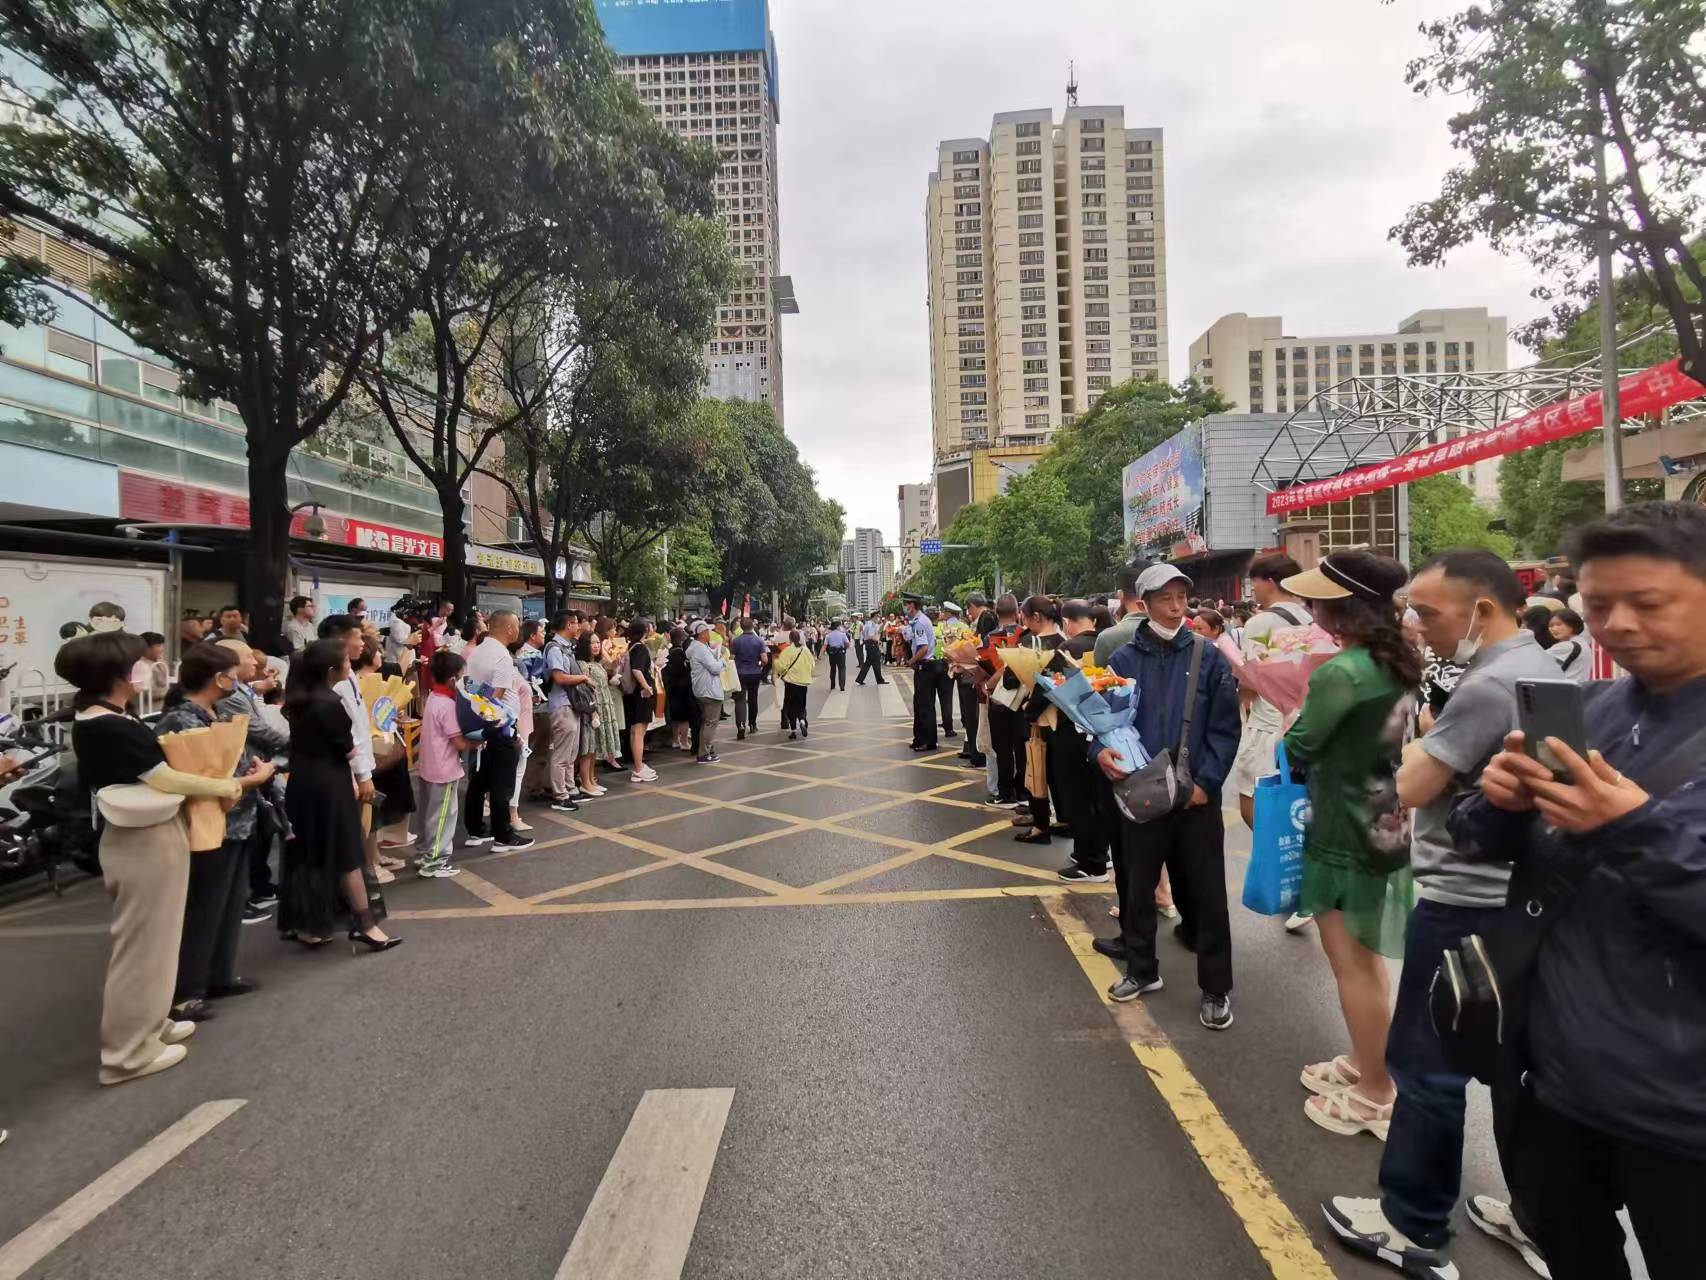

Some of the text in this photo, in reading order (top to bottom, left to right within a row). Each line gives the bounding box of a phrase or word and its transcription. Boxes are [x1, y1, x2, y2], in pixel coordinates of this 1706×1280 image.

[356, 527, 441, 560] M&G 晨光文具
